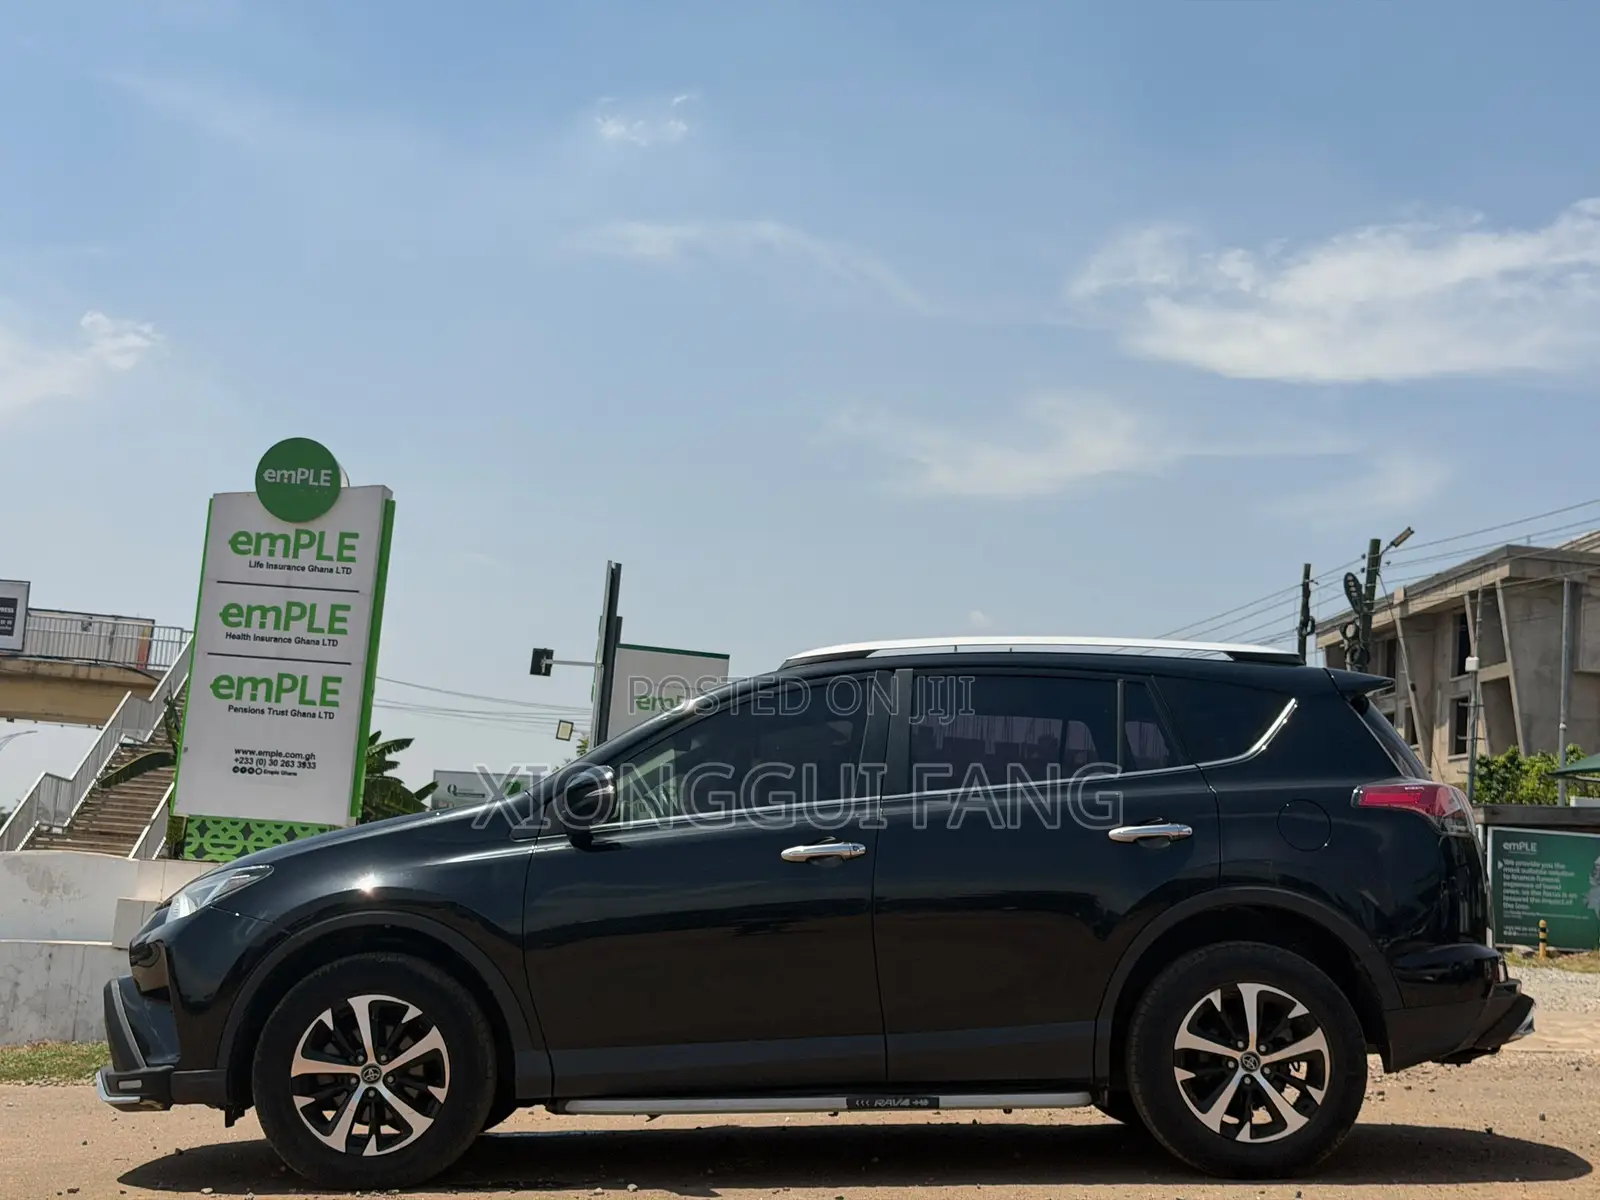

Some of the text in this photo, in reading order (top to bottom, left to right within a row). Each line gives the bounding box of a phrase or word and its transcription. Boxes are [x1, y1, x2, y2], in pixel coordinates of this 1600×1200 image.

[263, 468, 332, 486] emPLE
[228, 529, 360, 562] emPLE
[248, 560, 352, 575] Life Insurance Ghana LTD
[219, 601, 351, 635] emPLE
[225, 632, 338, 647] Health Insurance Ghana LTD
[209, 672, 342, 707] emPLE
[228, 704, 335, 720] Pensions Trust Ghana LTD
[234, 748, 316, 761] www.emple.com.gh
[234, 756, 254, 765] +233
[255, 758, 266, 767] (0)
[268, 758, 278, 767] 30
[280, 759, 295, 768] 263
[1502, 842, 1538, 852] emPLE
[874, 1099, 910, 1107] RAV4
